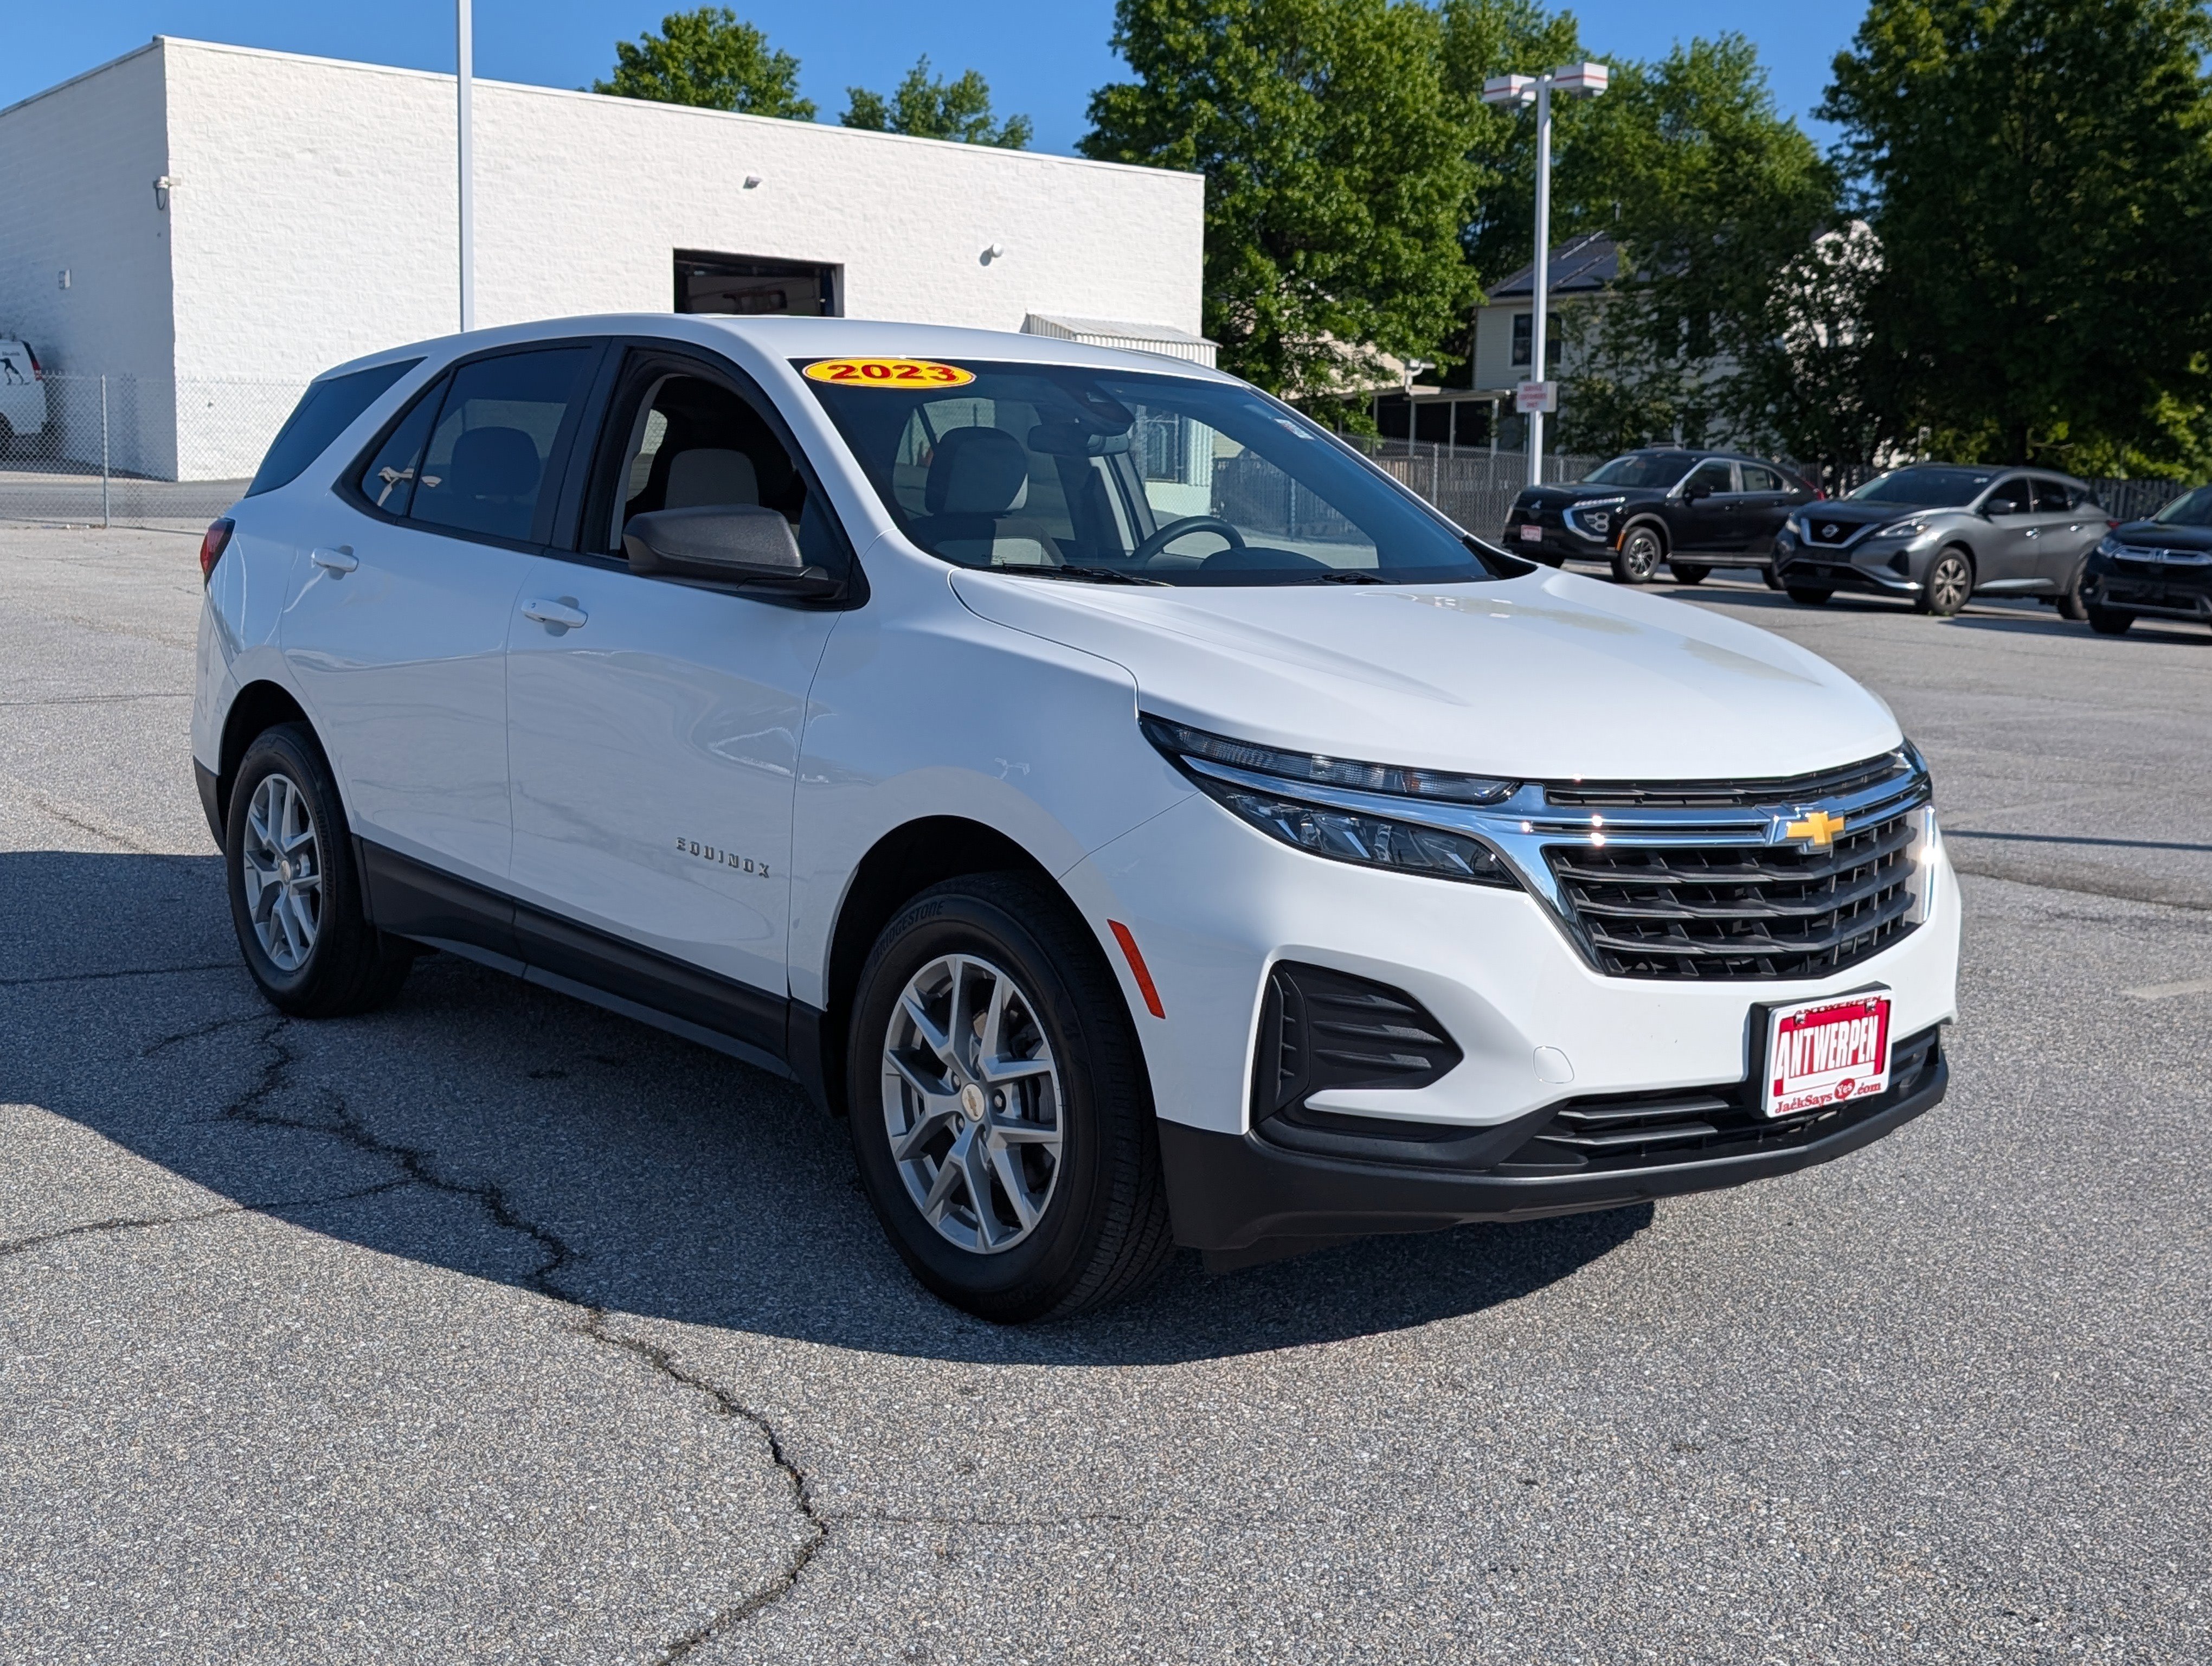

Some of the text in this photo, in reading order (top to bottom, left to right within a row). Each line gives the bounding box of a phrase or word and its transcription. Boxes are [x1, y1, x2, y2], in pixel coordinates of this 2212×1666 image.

[677, 837, 770, 879] EQUINOX
[827, 906, 959, 925] 2023
[1773, 1015, 1879, 1093] ANTWERPEN
